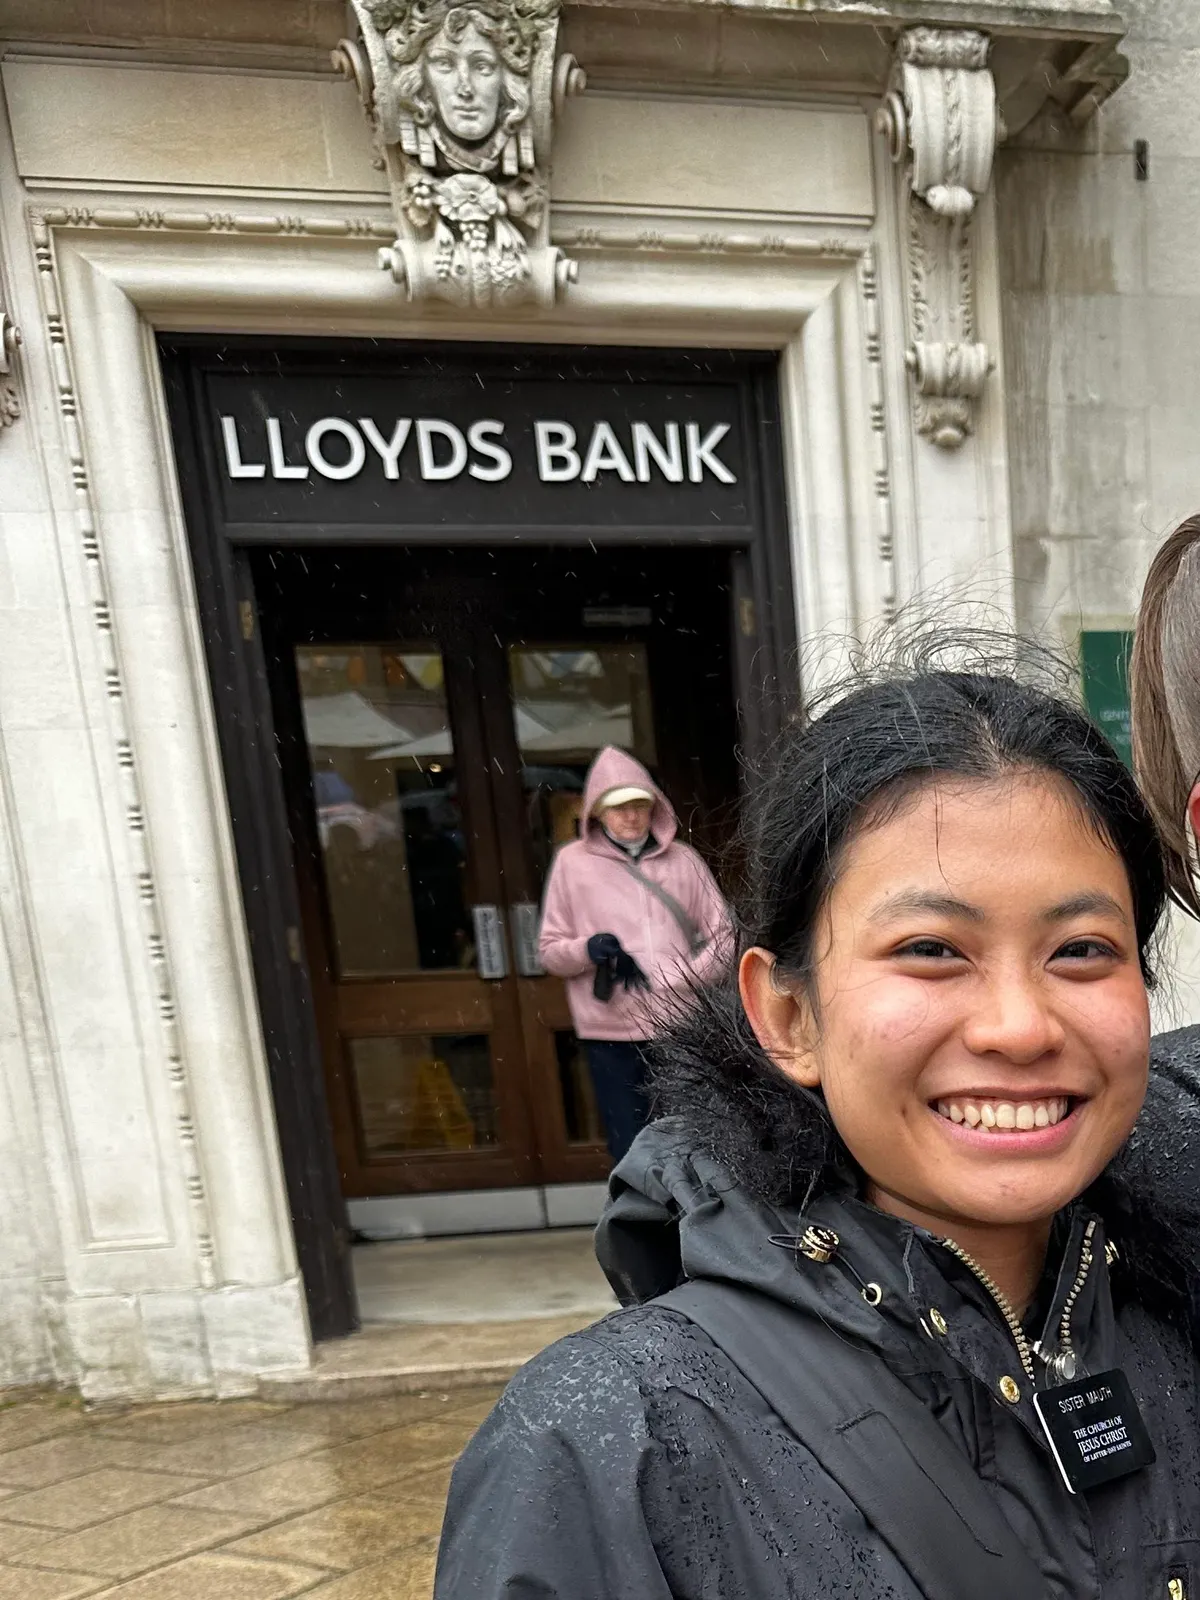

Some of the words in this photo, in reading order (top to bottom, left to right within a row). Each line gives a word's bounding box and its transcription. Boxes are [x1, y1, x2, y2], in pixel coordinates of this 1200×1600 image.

[220, 416, 512, 481] LLOYDS
[533, 420, 737, 484] BANK
[1058, 1395, 1086, 1413] SISTER
[1073, 1428, 1087, 1439] THE
[1087, 1419, 1114, 1434] CHURCH
[1113, 1415, 1123, 1426] OF
[1078, 1436, 1100, 1456] JESUS
[1100, 1427, 1127, 1445] CHRIST
